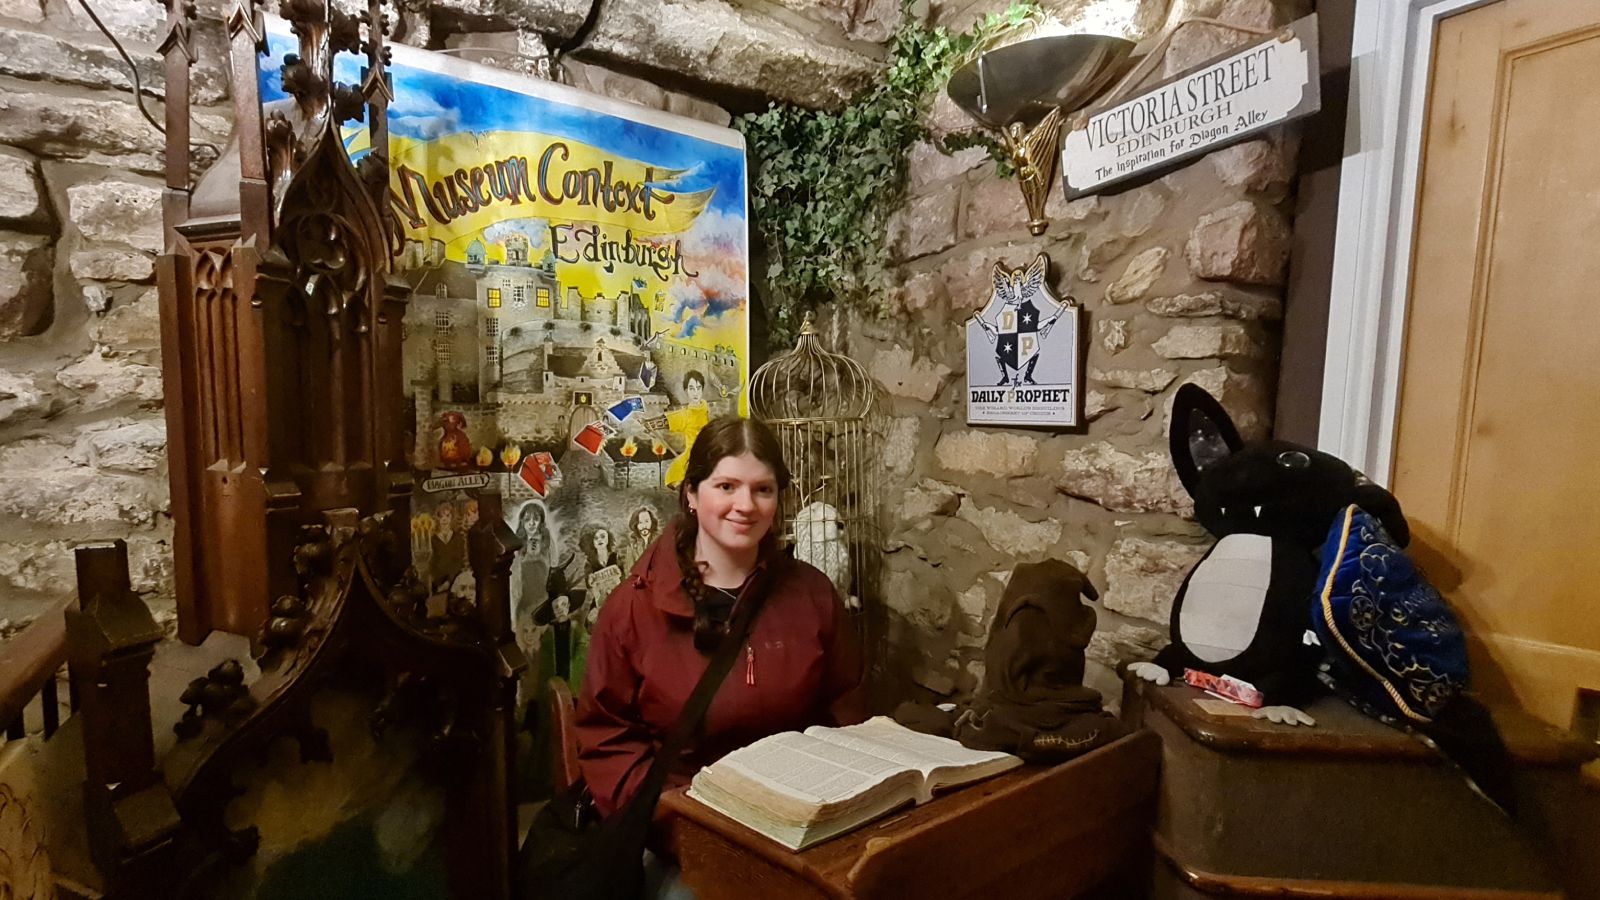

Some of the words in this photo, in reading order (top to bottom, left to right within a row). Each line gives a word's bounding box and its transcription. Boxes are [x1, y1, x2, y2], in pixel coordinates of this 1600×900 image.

[1086, 87, 1184, 151] VICTORIA
[1187, 45, 1276, 117] STREET
[1095, 165, 1113, 181] The
[1170, 138, 1185, 153] for
[1189, 125, 1229, 148] Diagon
[1234, 109, 1268, 132] Alley
[1116, 101, 1232, 157] EDINBURGH
[390, 156, 537, 256] Museum
[537, 142, 675, 220] Context
[550, 223, 699, 281] Edinburgh
[1021, 337, 1034, 355] P
[971, 390, 1006, 402] DAILY
[1007, 389, 1070, 403] PROPHET
